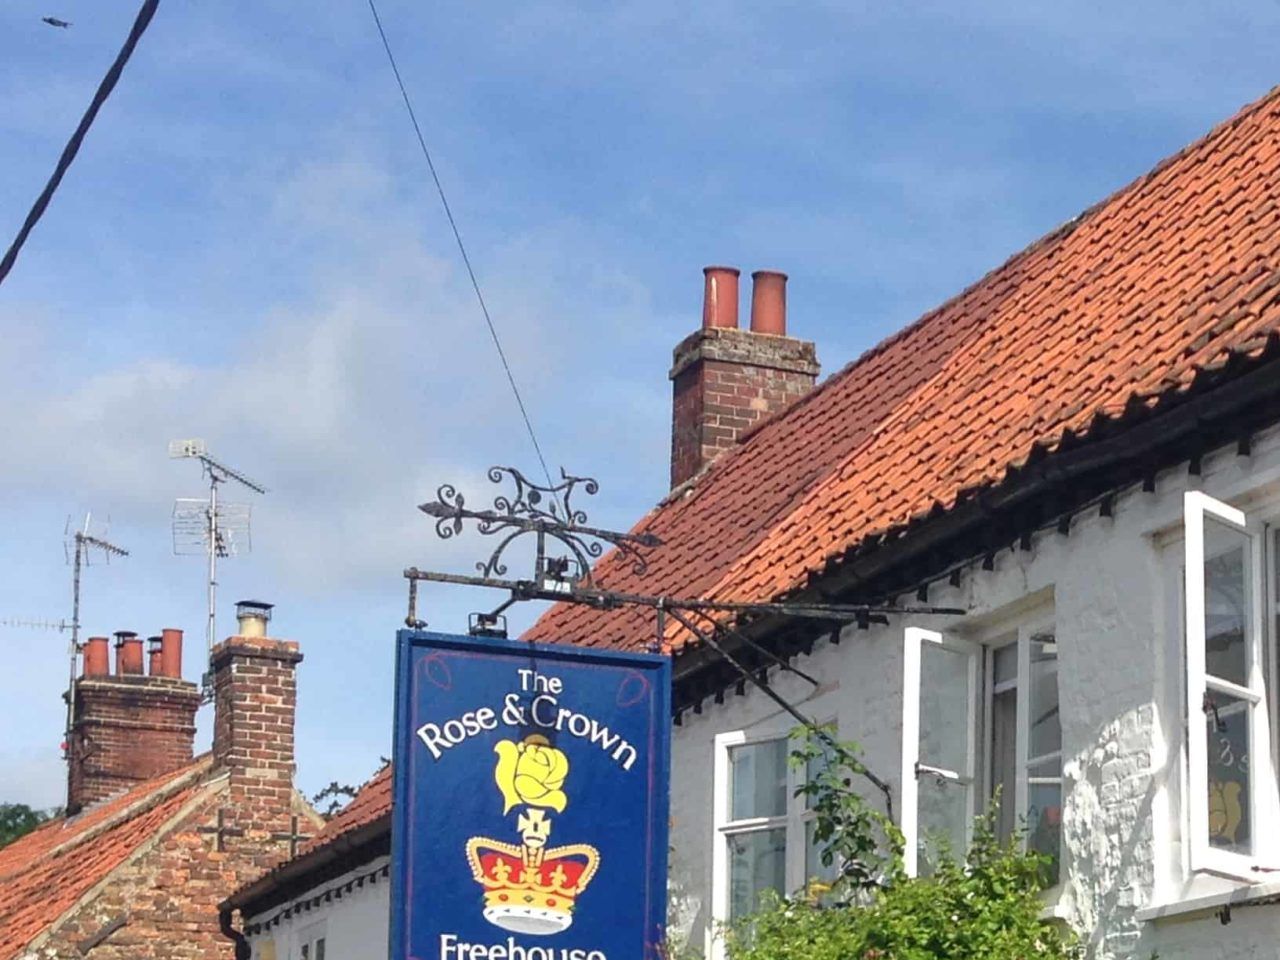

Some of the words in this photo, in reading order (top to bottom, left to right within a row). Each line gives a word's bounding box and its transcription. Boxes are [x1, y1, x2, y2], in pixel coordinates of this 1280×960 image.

[518, 668, 563, 694] The
[417, 706, 498, 759] Rose
[502, 693, 528, 726] &
[531, 694, 638, 771] Crown
